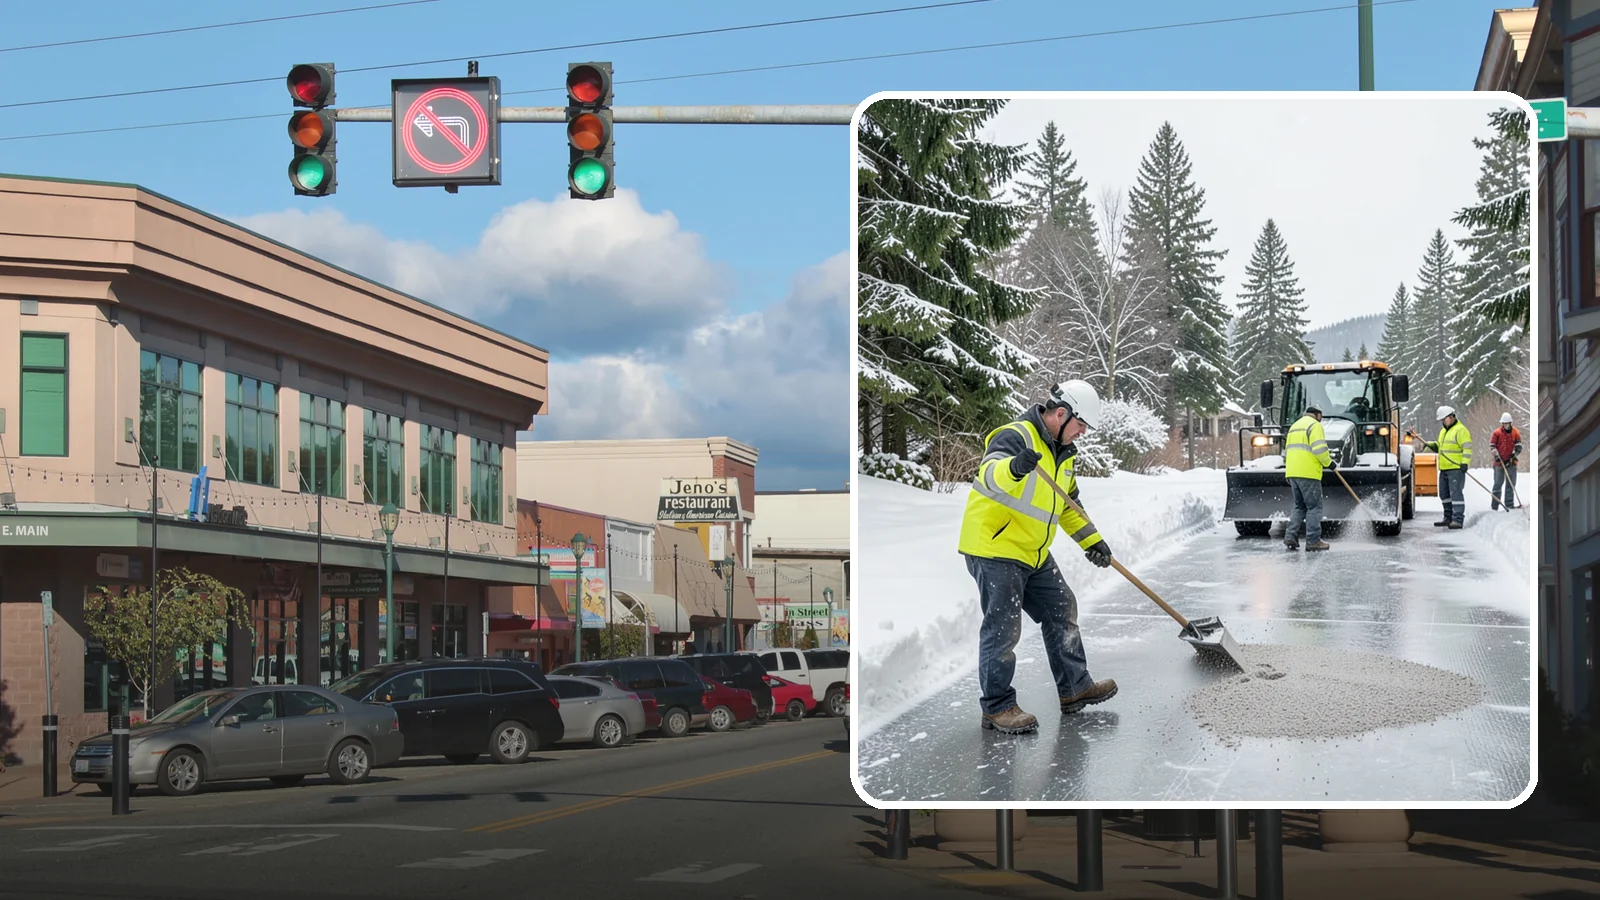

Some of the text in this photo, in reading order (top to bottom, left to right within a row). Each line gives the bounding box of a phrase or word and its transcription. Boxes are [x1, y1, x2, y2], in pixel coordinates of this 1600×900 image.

[670, 480, 727, 494] Jeno's
[665, 496, 731, 509] restaurant
[659, 510, 682, 519] Italian
[686, 509, 714, 519] American
[715, 509, 737, 519] Cuisine
[2, 525, 49, 536] E. MAIN
[797, 607, 828, 617] Street
